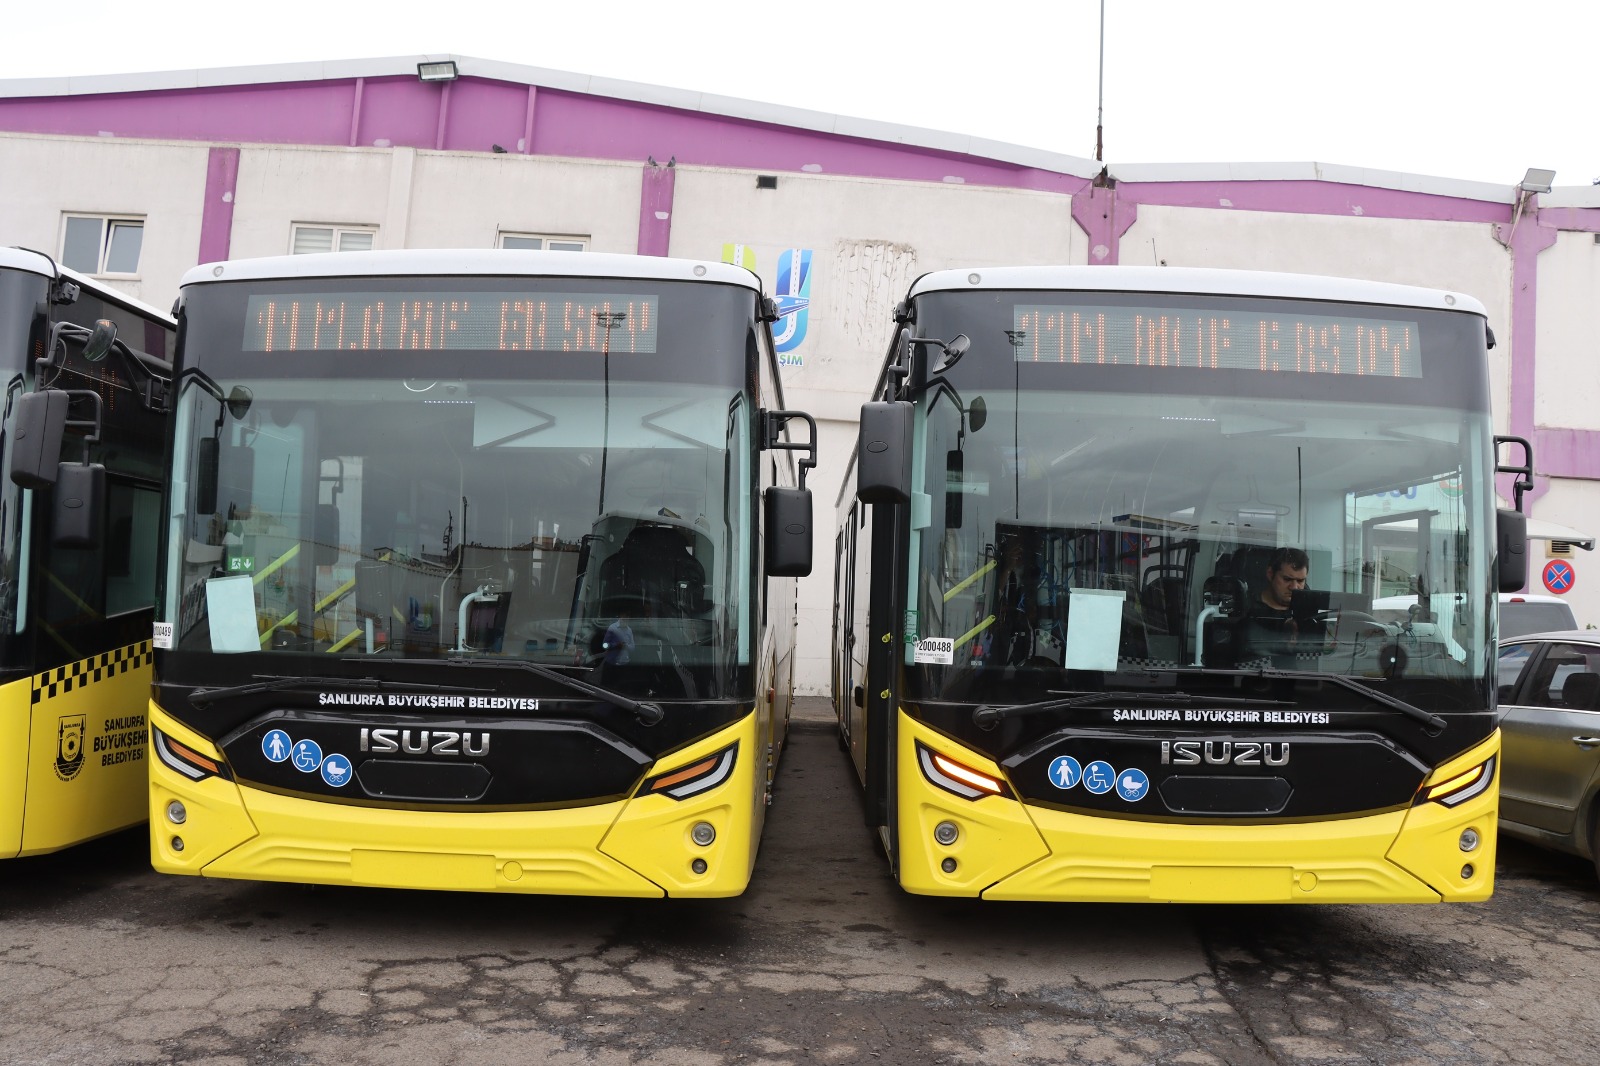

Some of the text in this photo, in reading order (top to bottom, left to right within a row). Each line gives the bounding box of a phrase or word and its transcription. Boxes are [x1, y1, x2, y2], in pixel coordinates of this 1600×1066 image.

[778, 354, 803, 368] ŞIM
[319, 693, 539, 711] ŞANLIURFA BÜYÜKŞEHİR BELEDİYESİ
[104, 714, 145, 733] ŞANLIURFA
[1113, 709, 1330, 724] ŞANLIURFA BÜYÜKŞEHİR BELEDİYESİ
[93, 729, 149, 753] BÜYÜKŞEHİ
[360, 727, 491, 757] ISUZU
[101, 748, 144, 767] BELEDİYESİ
[1161, 741, 1290, 766] ISUZU
